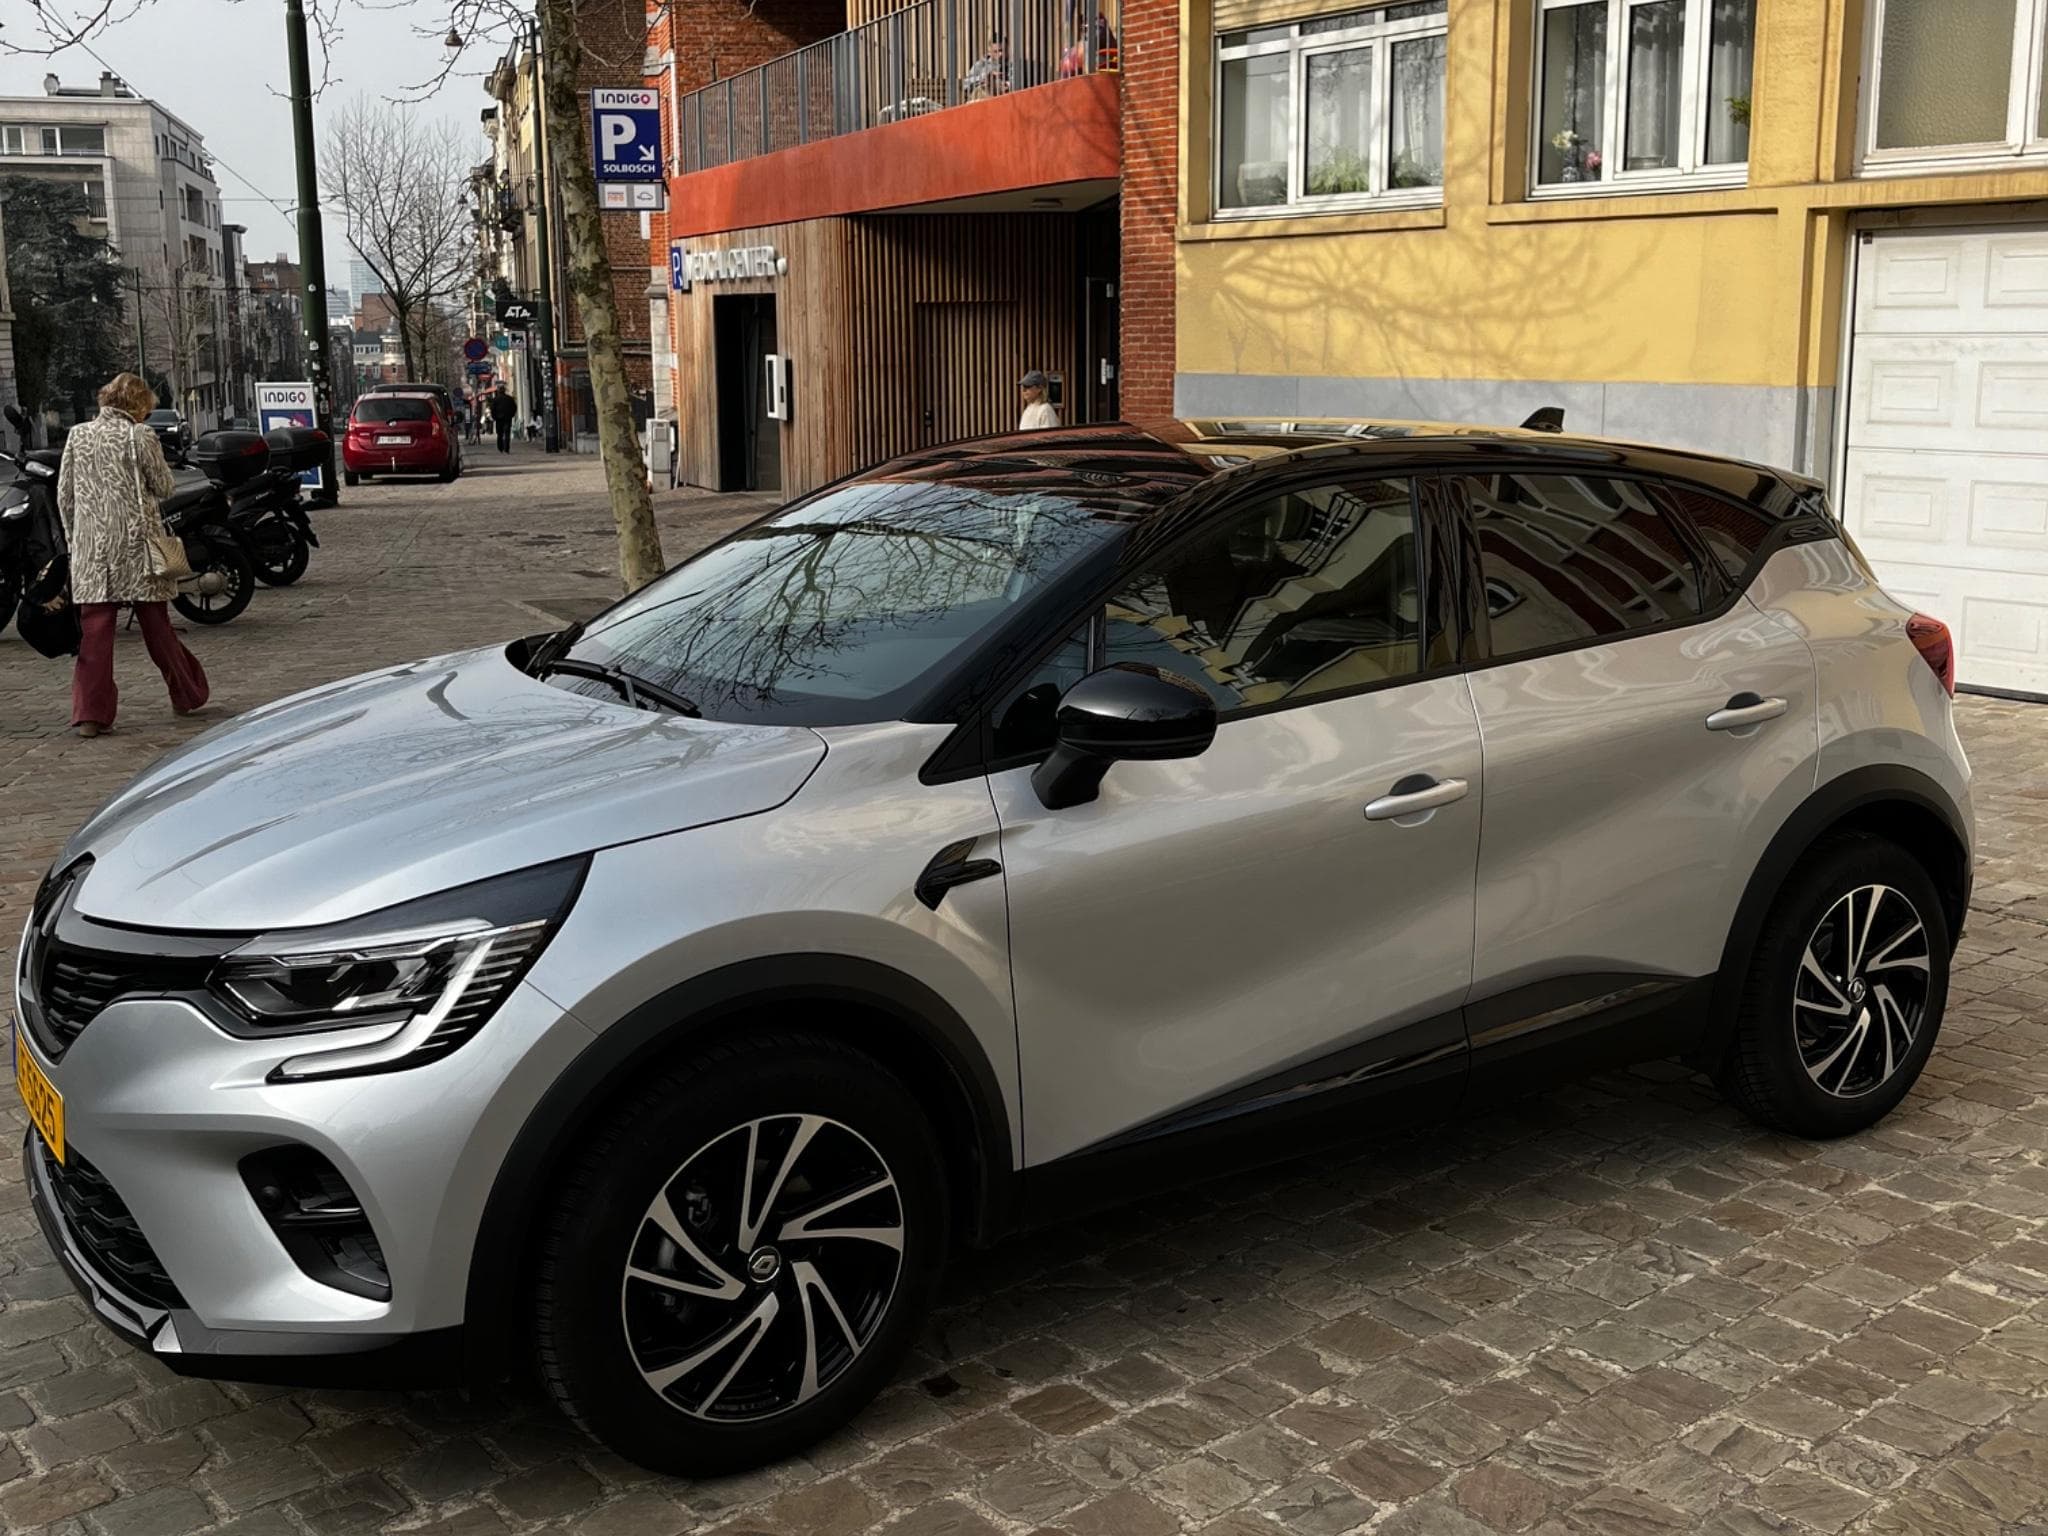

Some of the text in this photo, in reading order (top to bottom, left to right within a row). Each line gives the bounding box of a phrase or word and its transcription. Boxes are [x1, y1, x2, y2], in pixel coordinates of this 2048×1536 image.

[601, 93, 651, 105] INDIGO
[600, 114, 637, 161] P
[603, 163, 656, 174] SOLBOSCH
[728, 246, 776, 279] CENTER
[264, 391, 307, 404] INDIGO
